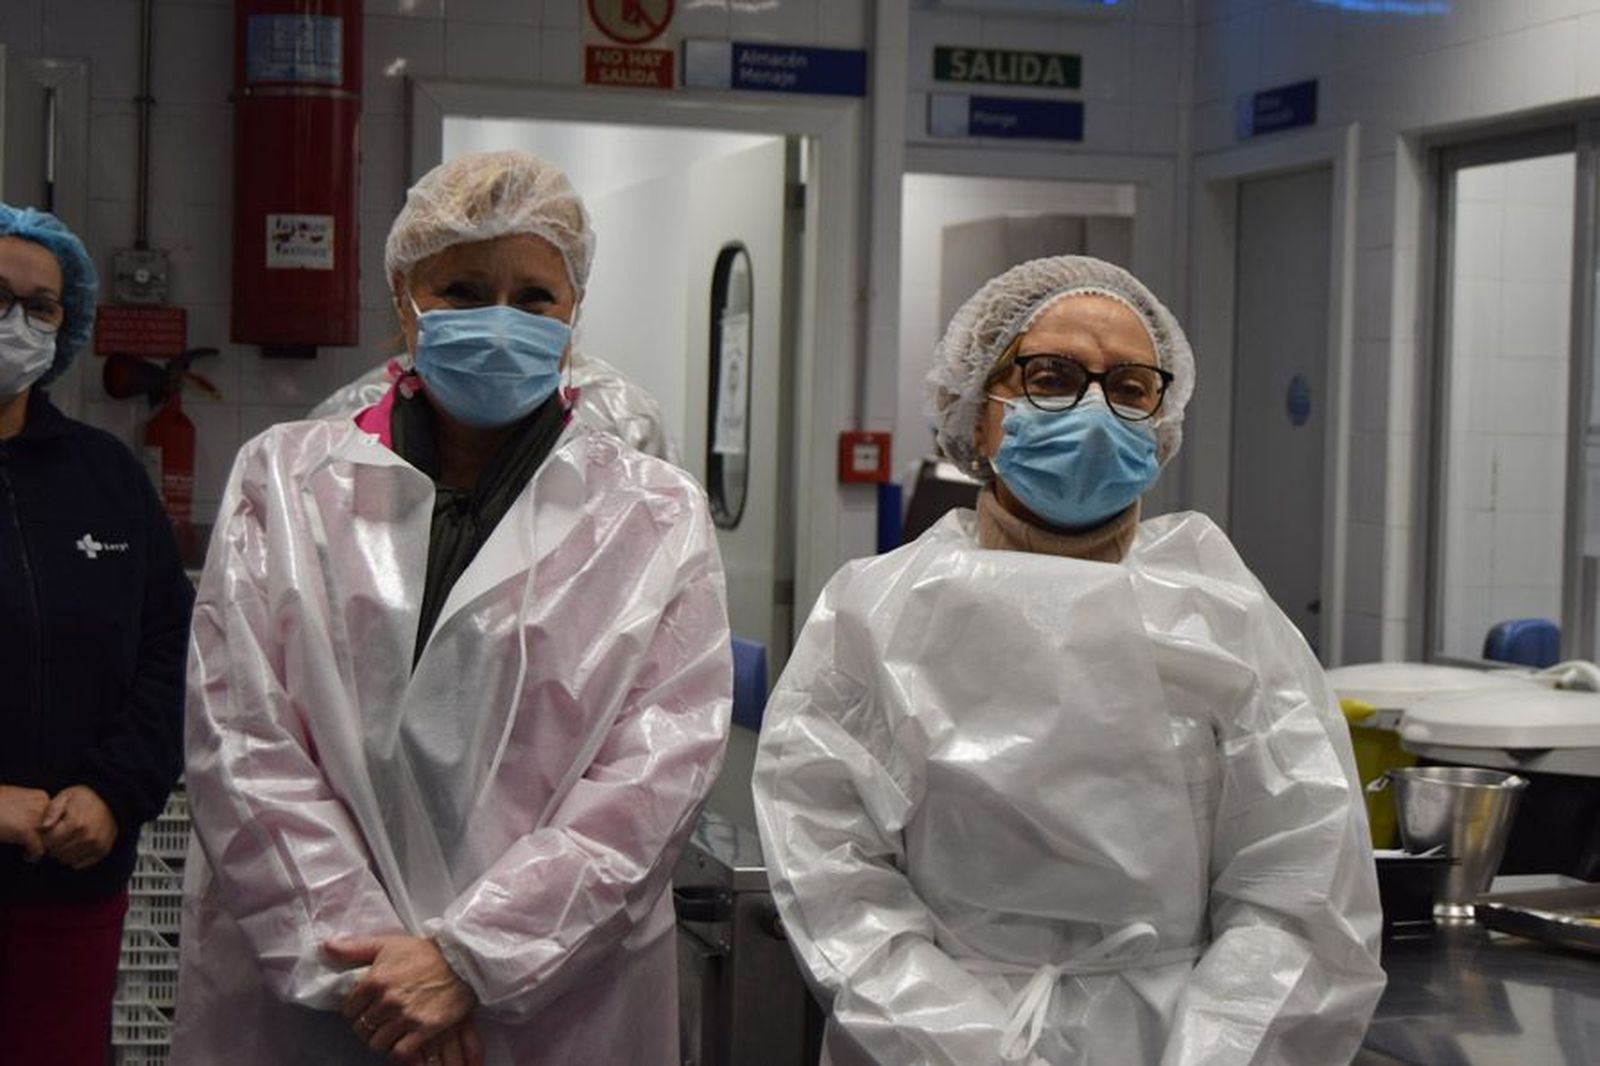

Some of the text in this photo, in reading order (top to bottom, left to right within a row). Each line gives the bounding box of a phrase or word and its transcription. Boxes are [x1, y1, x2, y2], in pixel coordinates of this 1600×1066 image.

[595, 51, 663, 67] NO HAY
[740, 50, 808, 67] Almacén
[598, 68, 658, 85] SALIDA
[740, 68, 797, 86] Menaje
[950, 51, 1065, 86] SALIDA
